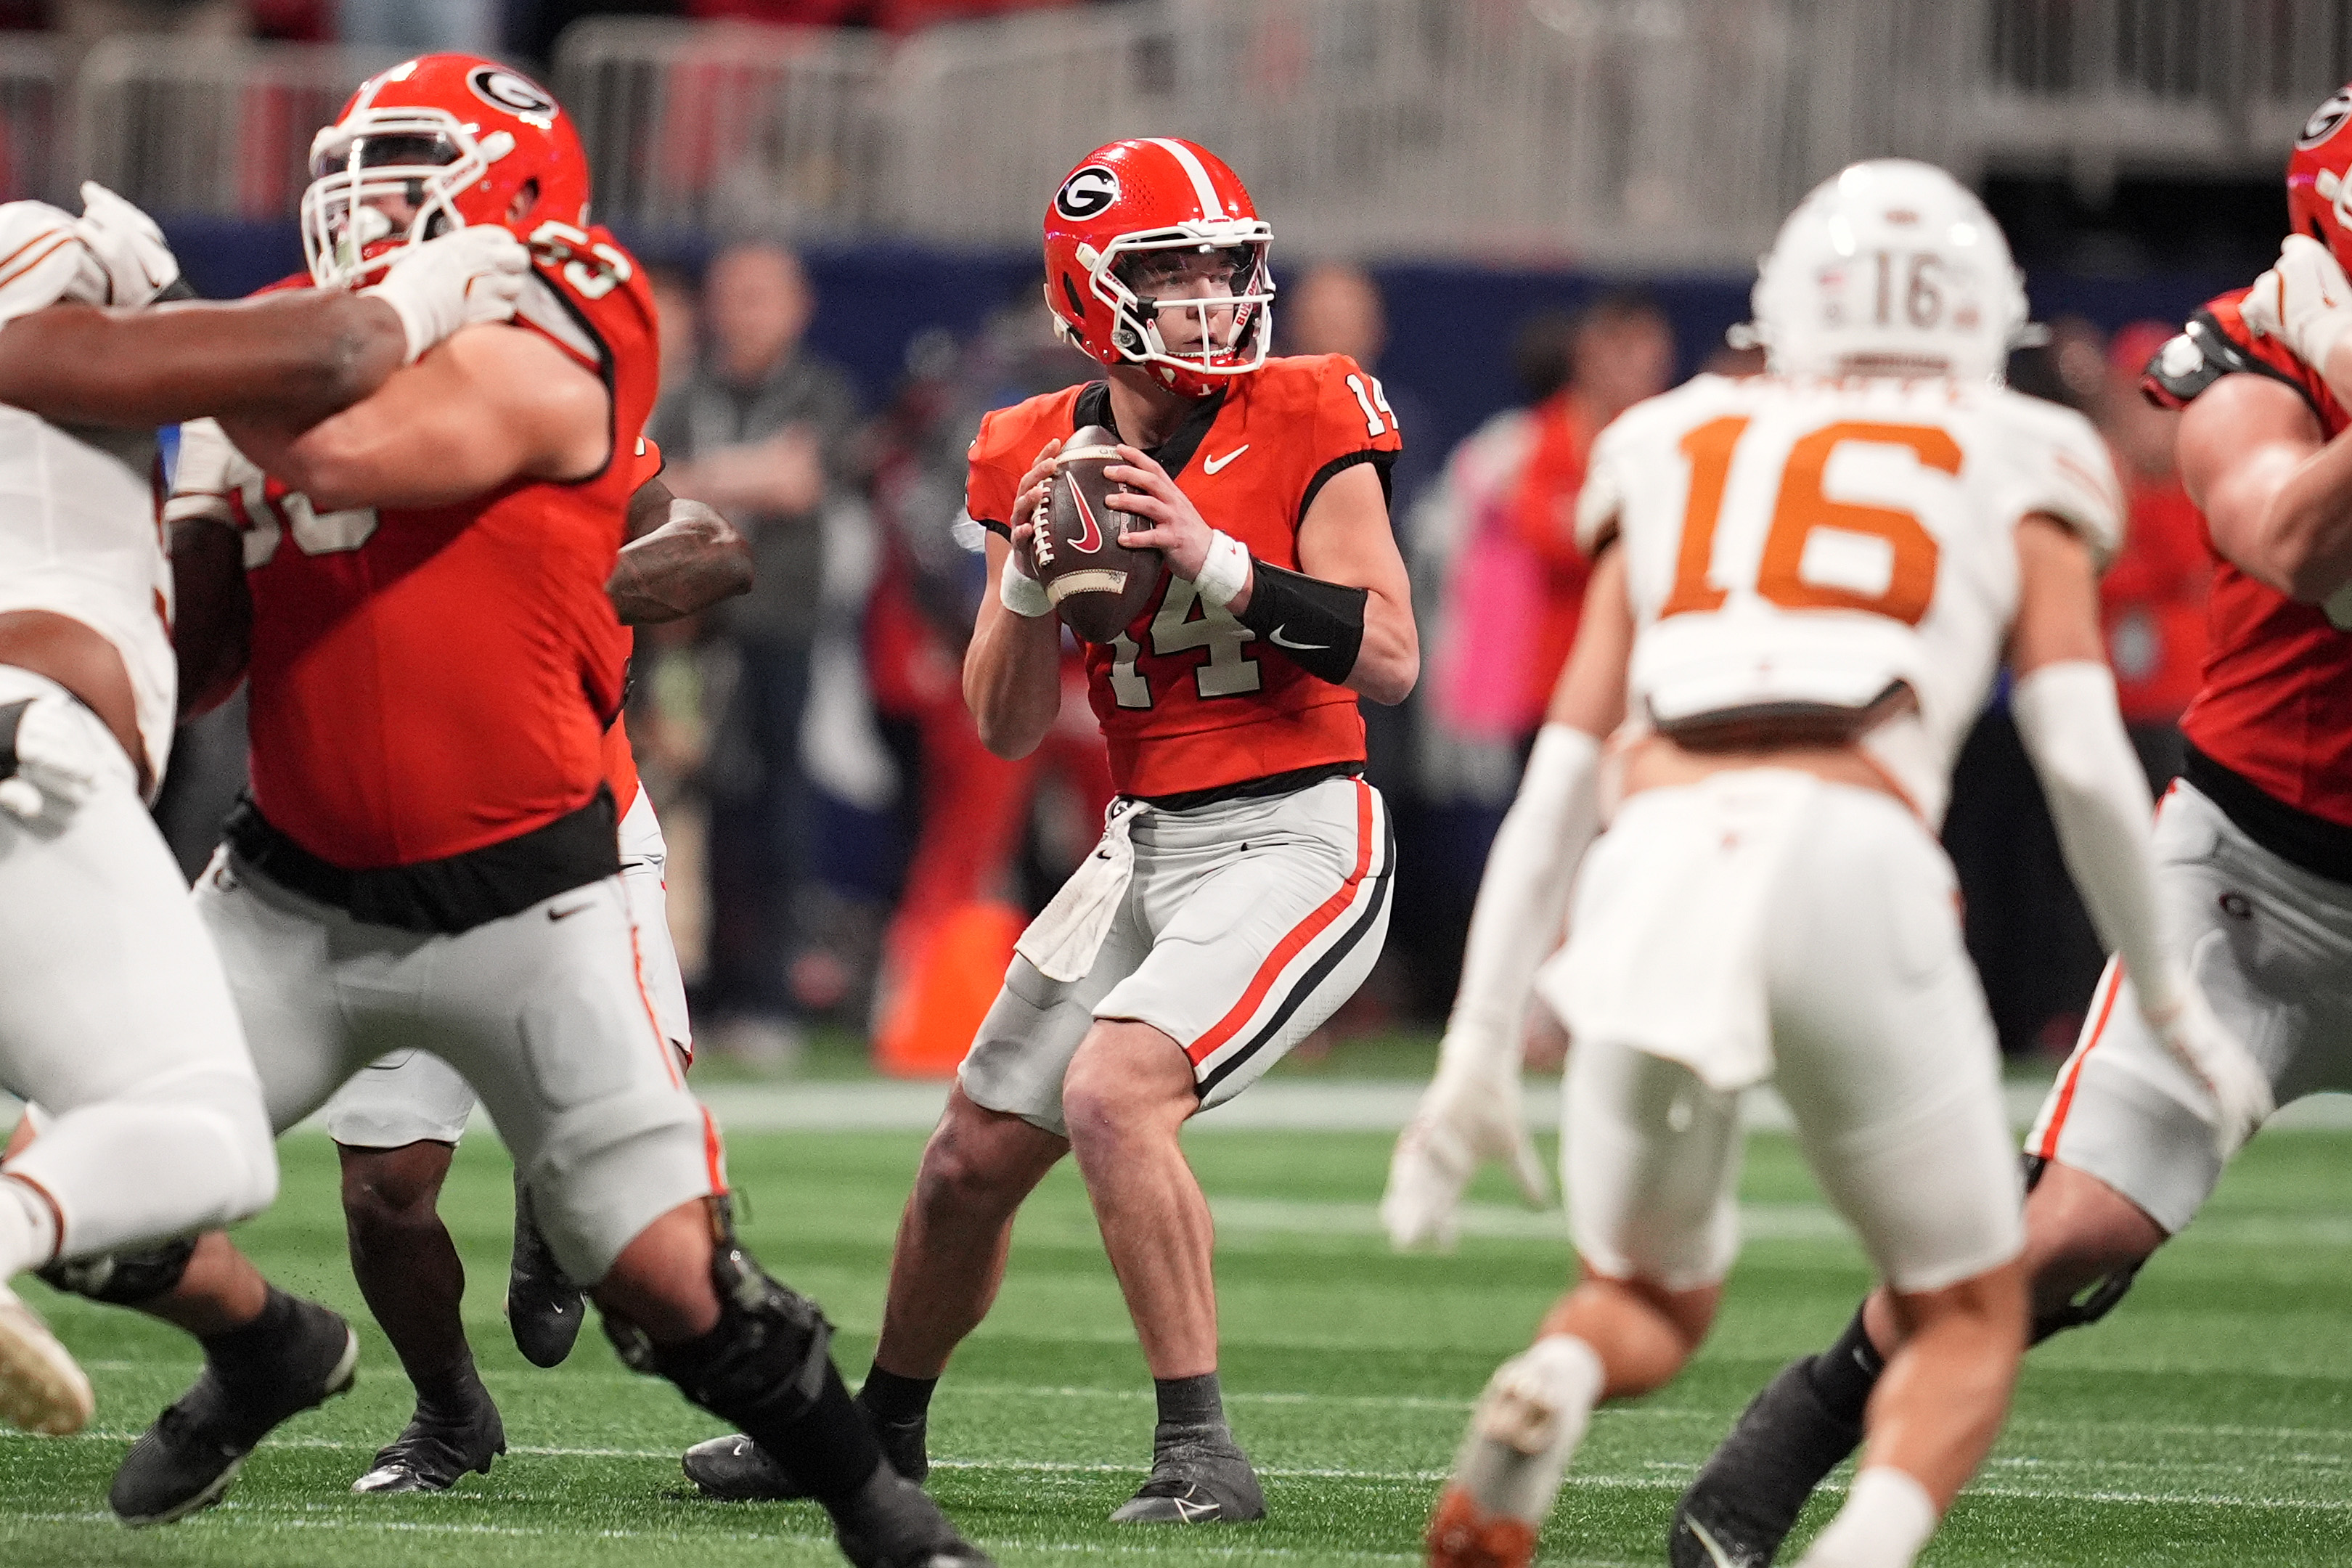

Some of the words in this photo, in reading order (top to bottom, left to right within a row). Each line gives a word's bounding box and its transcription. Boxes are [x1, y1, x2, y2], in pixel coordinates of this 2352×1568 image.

[1874, 249, 1943, 330] 16
[1345, 372, 1400, 437] 14
[1658, 413, 1964, 627] 16
[1106, 572, 1261, 709] 14
